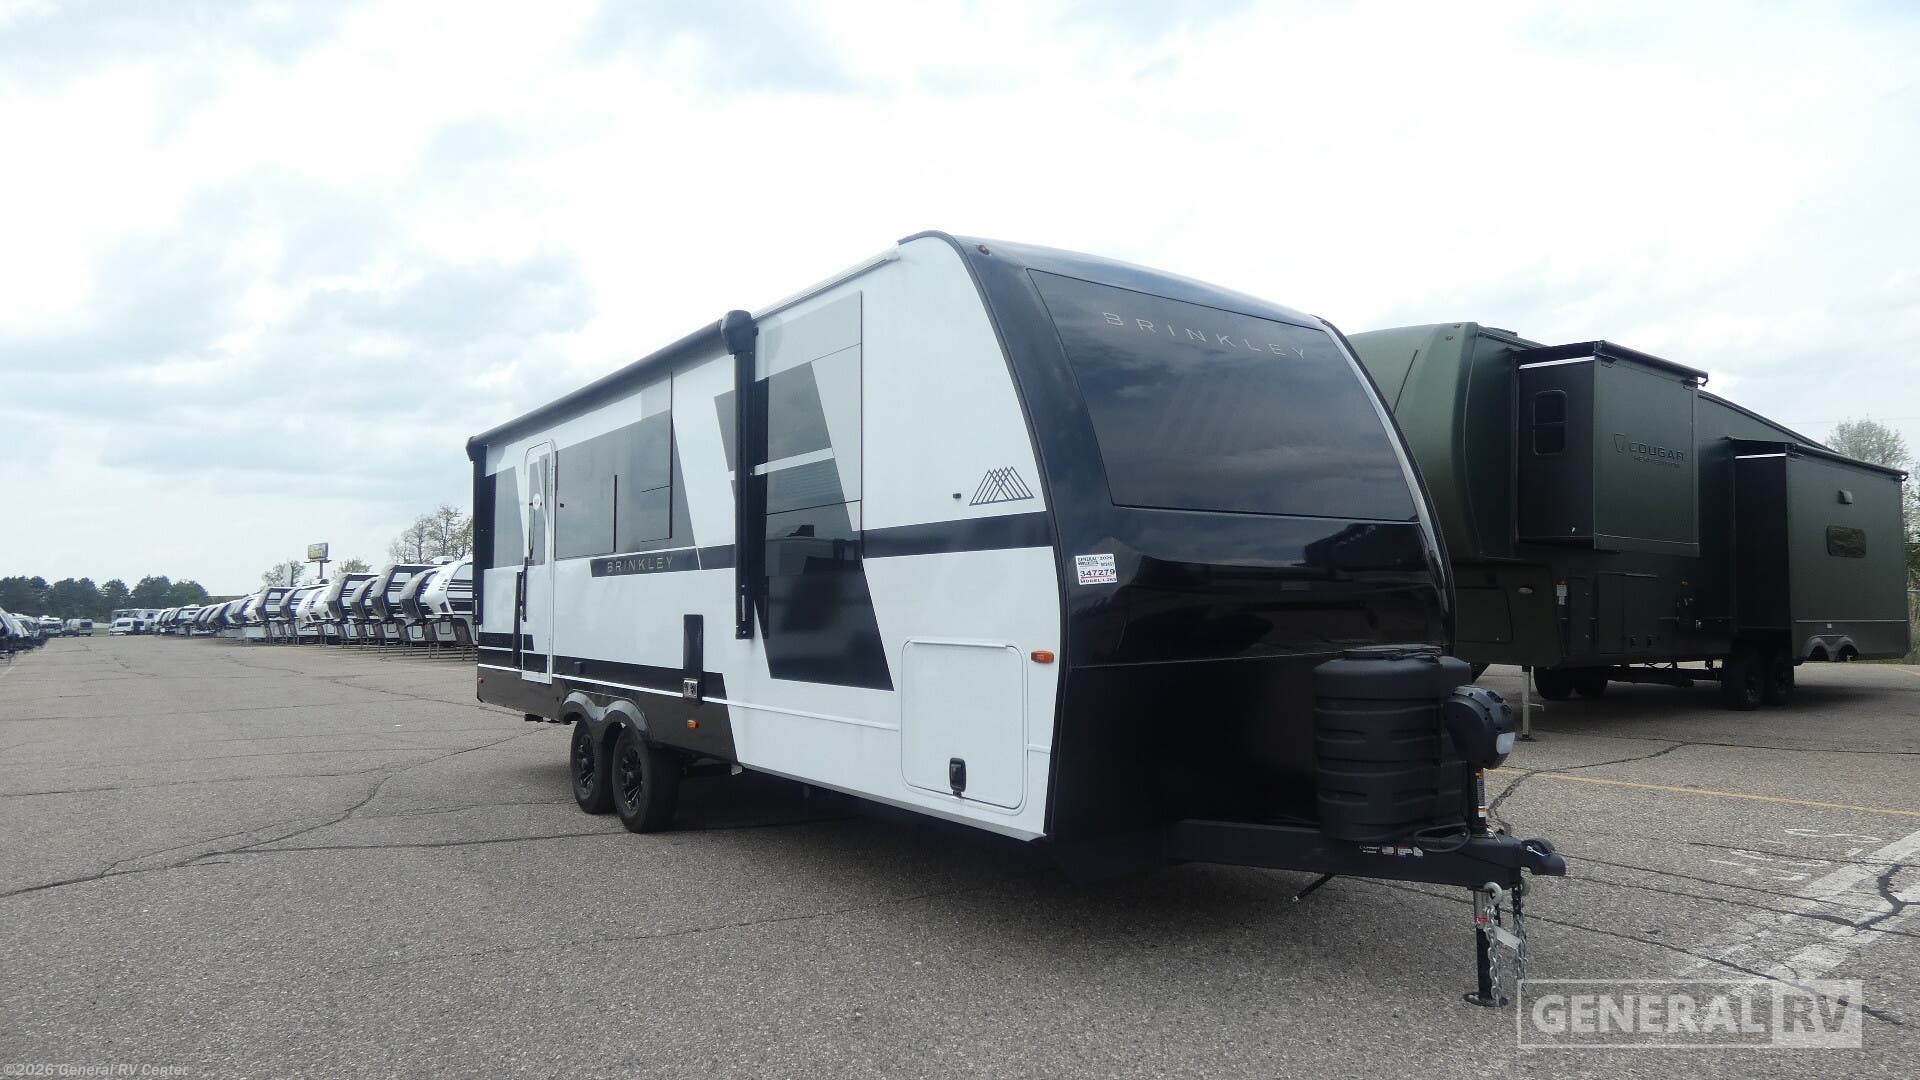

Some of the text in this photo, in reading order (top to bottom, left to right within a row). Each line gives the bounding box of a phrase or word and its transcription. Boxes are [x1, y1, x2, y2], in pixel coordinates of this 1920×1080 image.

[1102, 311, 1304, 359] BRINKLEY
[1629, 441, 1684, 462] COUGAR
[607, 556, 673, 573] BRINKLEY
[1080, 569, 1116, 577] 347279
